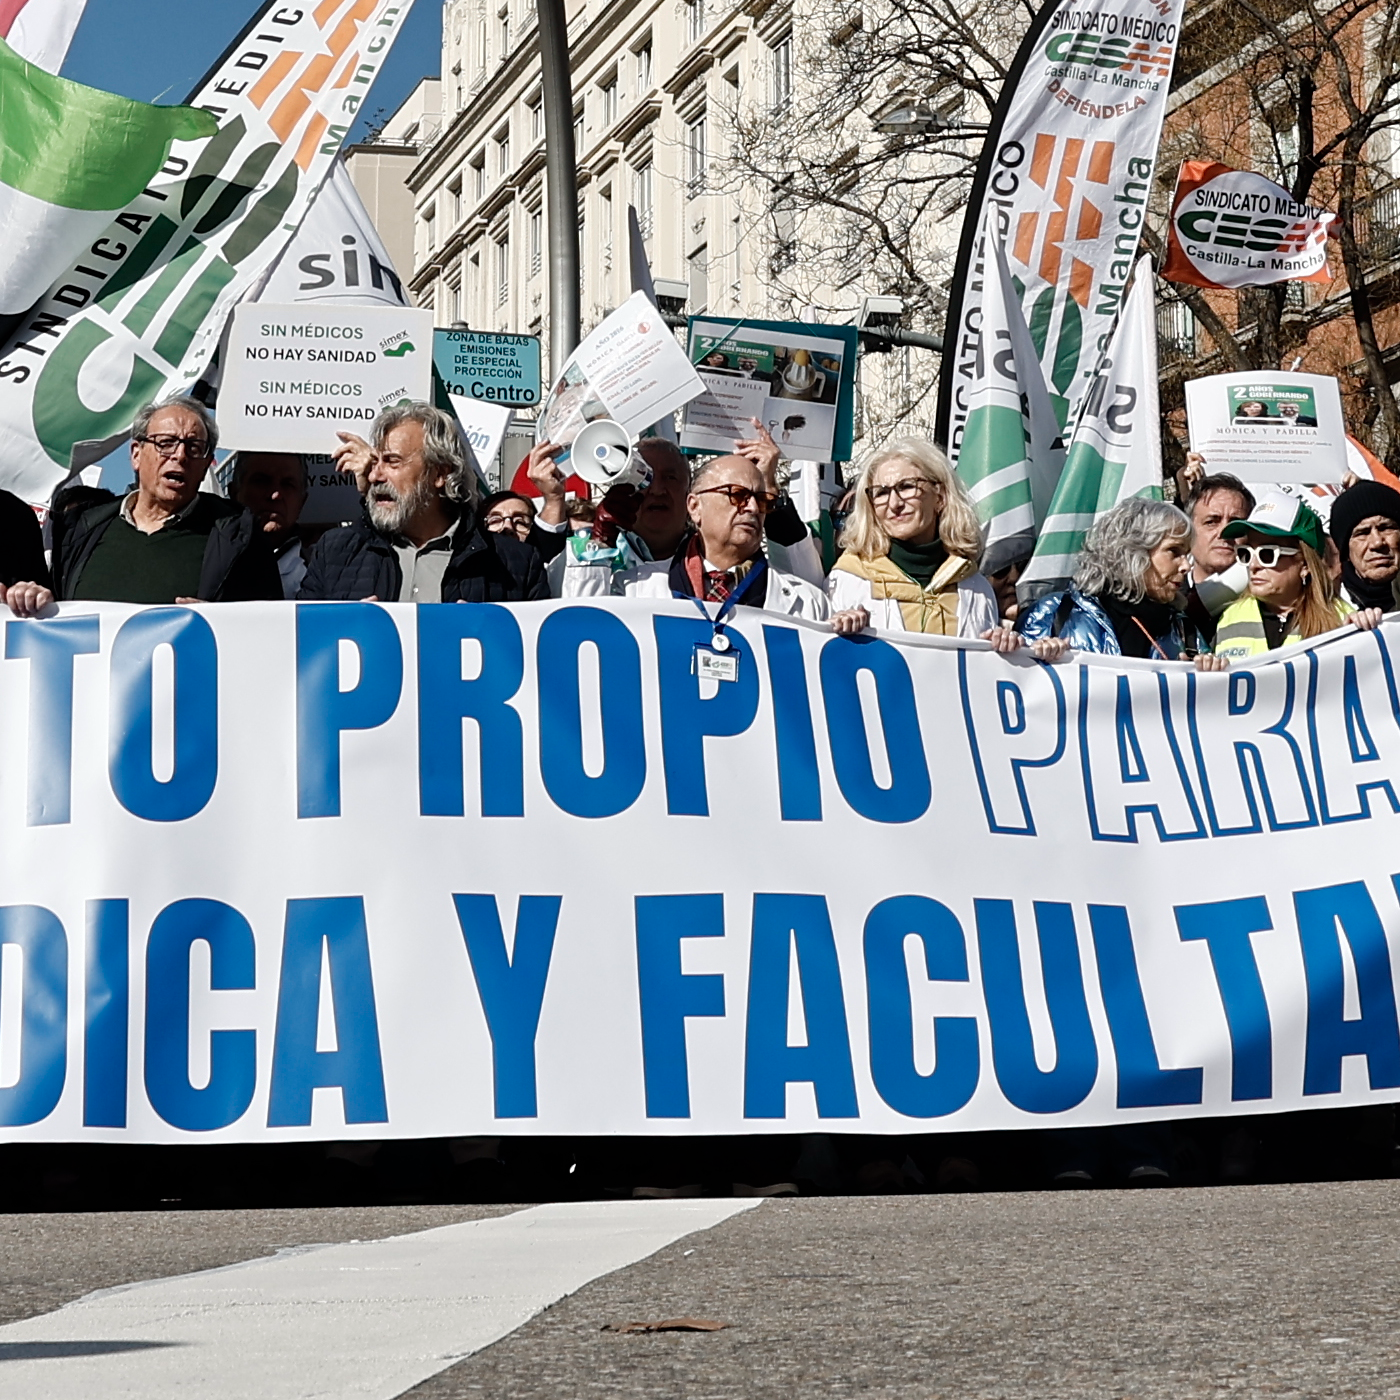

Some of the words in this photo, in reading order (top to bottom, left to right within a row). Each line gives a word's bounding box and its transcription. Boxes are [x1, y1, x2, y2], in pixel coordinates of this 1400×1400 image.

[1052, 10, 1119, 35] SINDICATO
[1121, 13, 1177, 44] MÉDICO
[1045, 33, 1173, 78] CESM
[1112, 73, 1160, 91] Mancha
[1047, 78, 1147, 120] DEFIÉNDELA
[1195, 189, 1270, 213] SINDICATO
[1095, 155, 1154, 316] Mancha
[1186, 245, 1265, 269] Castilla-La
[1271, 252, 1325, 271] Mancha
[260, 324, 287, 337] SIN
[291, 322, 364, 340] MÉDICOS
[378, 329, 409, 349] simex
[446, 332, 476, 343] ZONA
[479, 333, 493, 344] DE
[495, 335, 530, 347] BAJAS
[246, 347, 269, 360] NO
[273, 348, 304, 361] HAY
[307, 350, 377, 363] SANIDAD
[460, 344, 517, 357] EMISIONES
[454, 355, 469, 365] DE
[471, 355, 522, 368] ESPECIAL
[454, 366, 523, 379] PROTECCIÓN
[259, 381, 286, 394] SIN
[290, 379, 363, 396] MÉDICOS
[377, 386, 408, 405] simex
[471, 381, 535, 402] Centro
[1233, 387, 1247, 399] 2
[244, 404, 268, 417] NO
[272, 405, 303, 418] HAY
[306, 406, 376, 420] SANIDAD
[1216, 427, 1256, 435] MÓNICA
[1276, 428, 1318, 436] PADILLA
[295, 602, 933, 825] PROPIO
[451, 892, 564, 1119] Y
[634, 872, 1400, 1119] FACULTA
